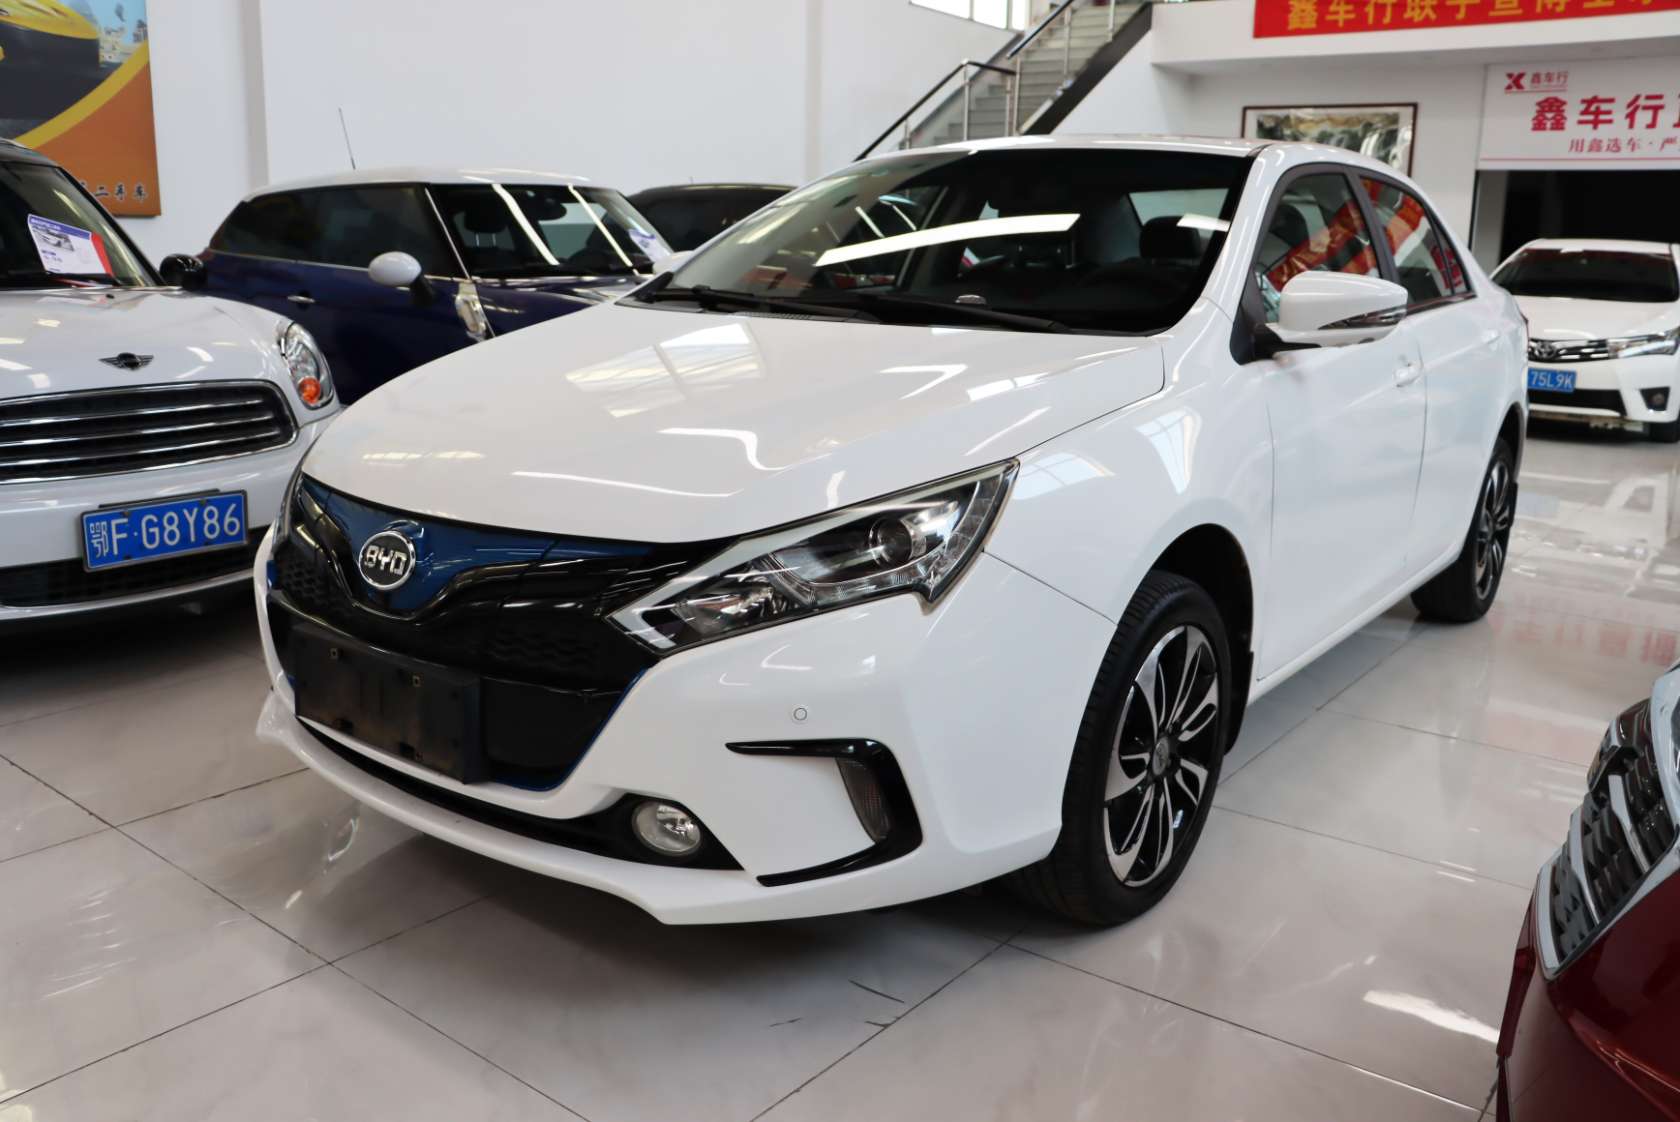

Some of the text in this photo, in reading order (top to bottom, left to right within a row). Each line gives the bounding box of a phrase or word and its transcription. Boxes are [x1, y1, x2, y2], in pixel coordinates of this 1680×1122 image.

[1532, 94, 1680, 132] 鑫车行
[364, 545, 407, 576] BYD
